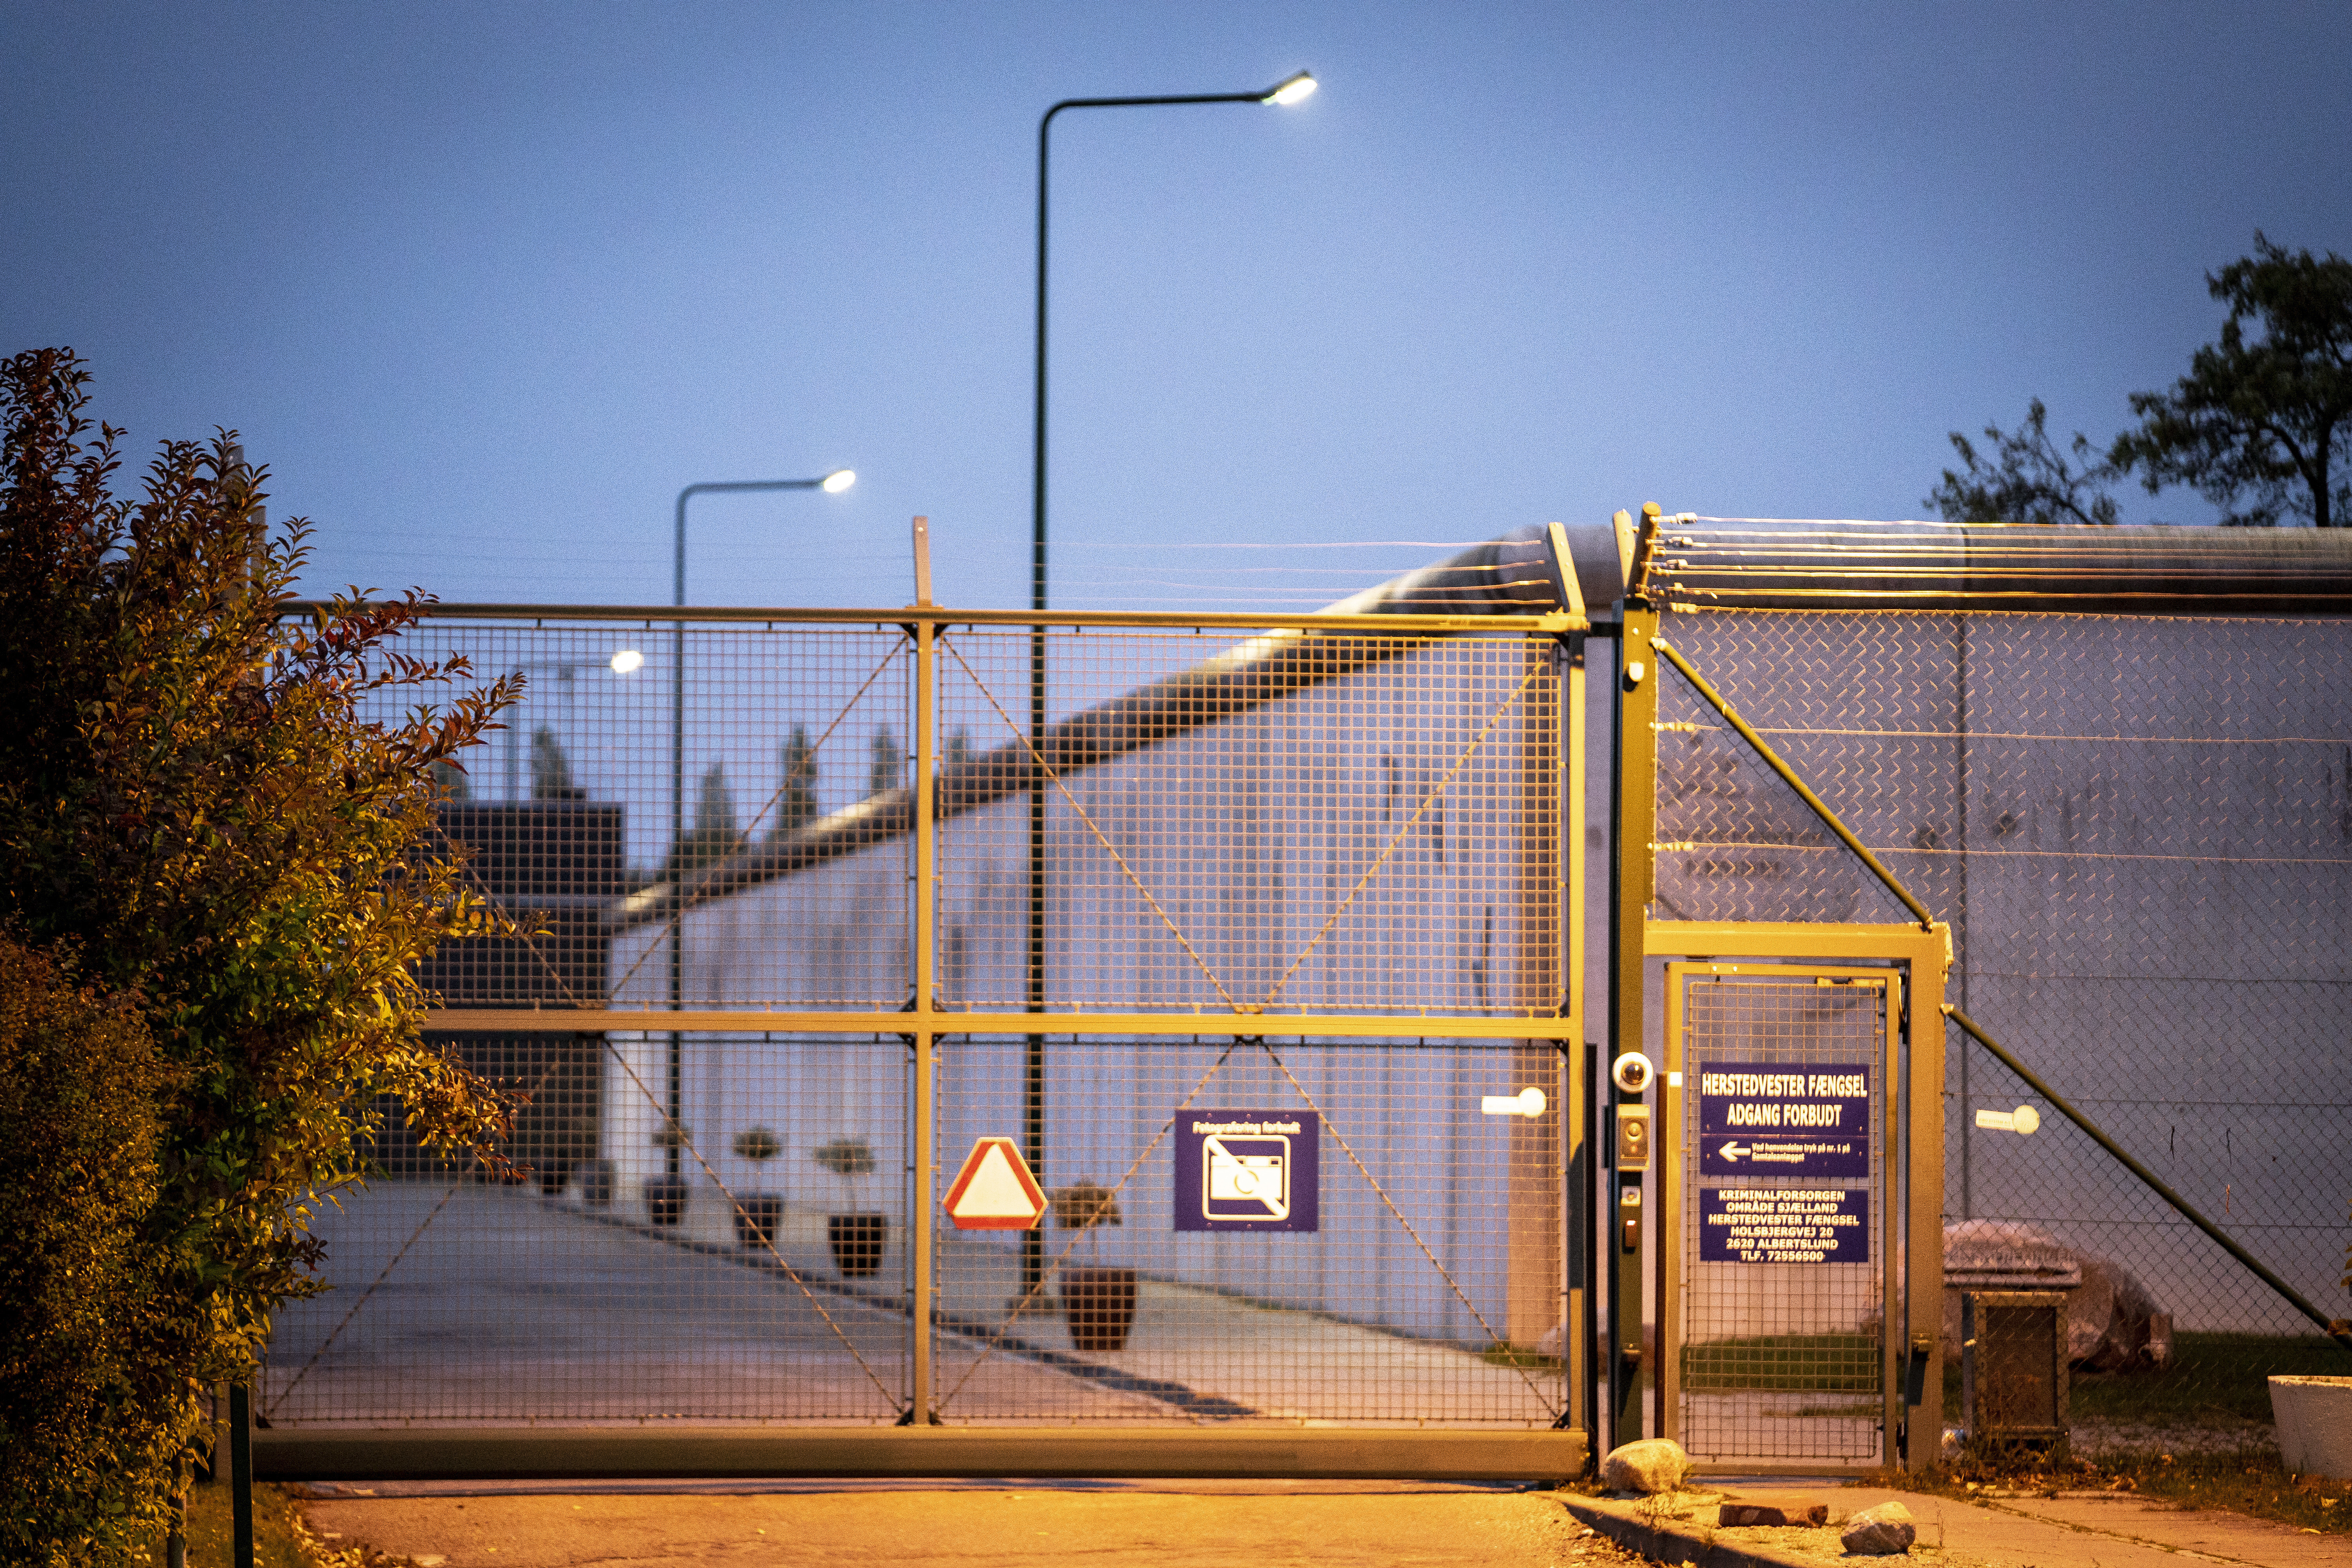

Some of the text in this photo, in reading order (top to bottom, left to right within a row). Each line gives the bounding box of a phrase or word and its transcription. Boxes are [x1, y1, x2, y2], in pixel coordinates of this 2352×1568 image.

[1703, 1073, 1867, 1097] HERSTEDVESTER FÆNGSEL
[1727, 1103, 1842, 1126] ADGANG FORBUDT
[1752, 1143, 1764, 1153] Ved
[1765, 1143, 1803, 1153] henvendelse
[1804, 1144, 1817, 1153] tryk
[1818, 1143, 1826, 1153] på
[1837, 1144, 1841, 1153] 1
[1842, 1144, 1850, 1153] på
[1719, 1190, 1845, 1201] KRIMINALFORSORGEN
[1726, 1200, 1838, 1214] OMRÅDE SJÆLLAND
[1709, 1214, 1859, 1225] HERSTEDVESTER FÆNGSEL
[1731, 1227, 1833, 1238] HOLSBJERGVEJ 20
[1727, 1238, 1838, 1249] 2620 ALBERTSLUND
[1741, 1250, 1823, 1261] TLF. 72556500
